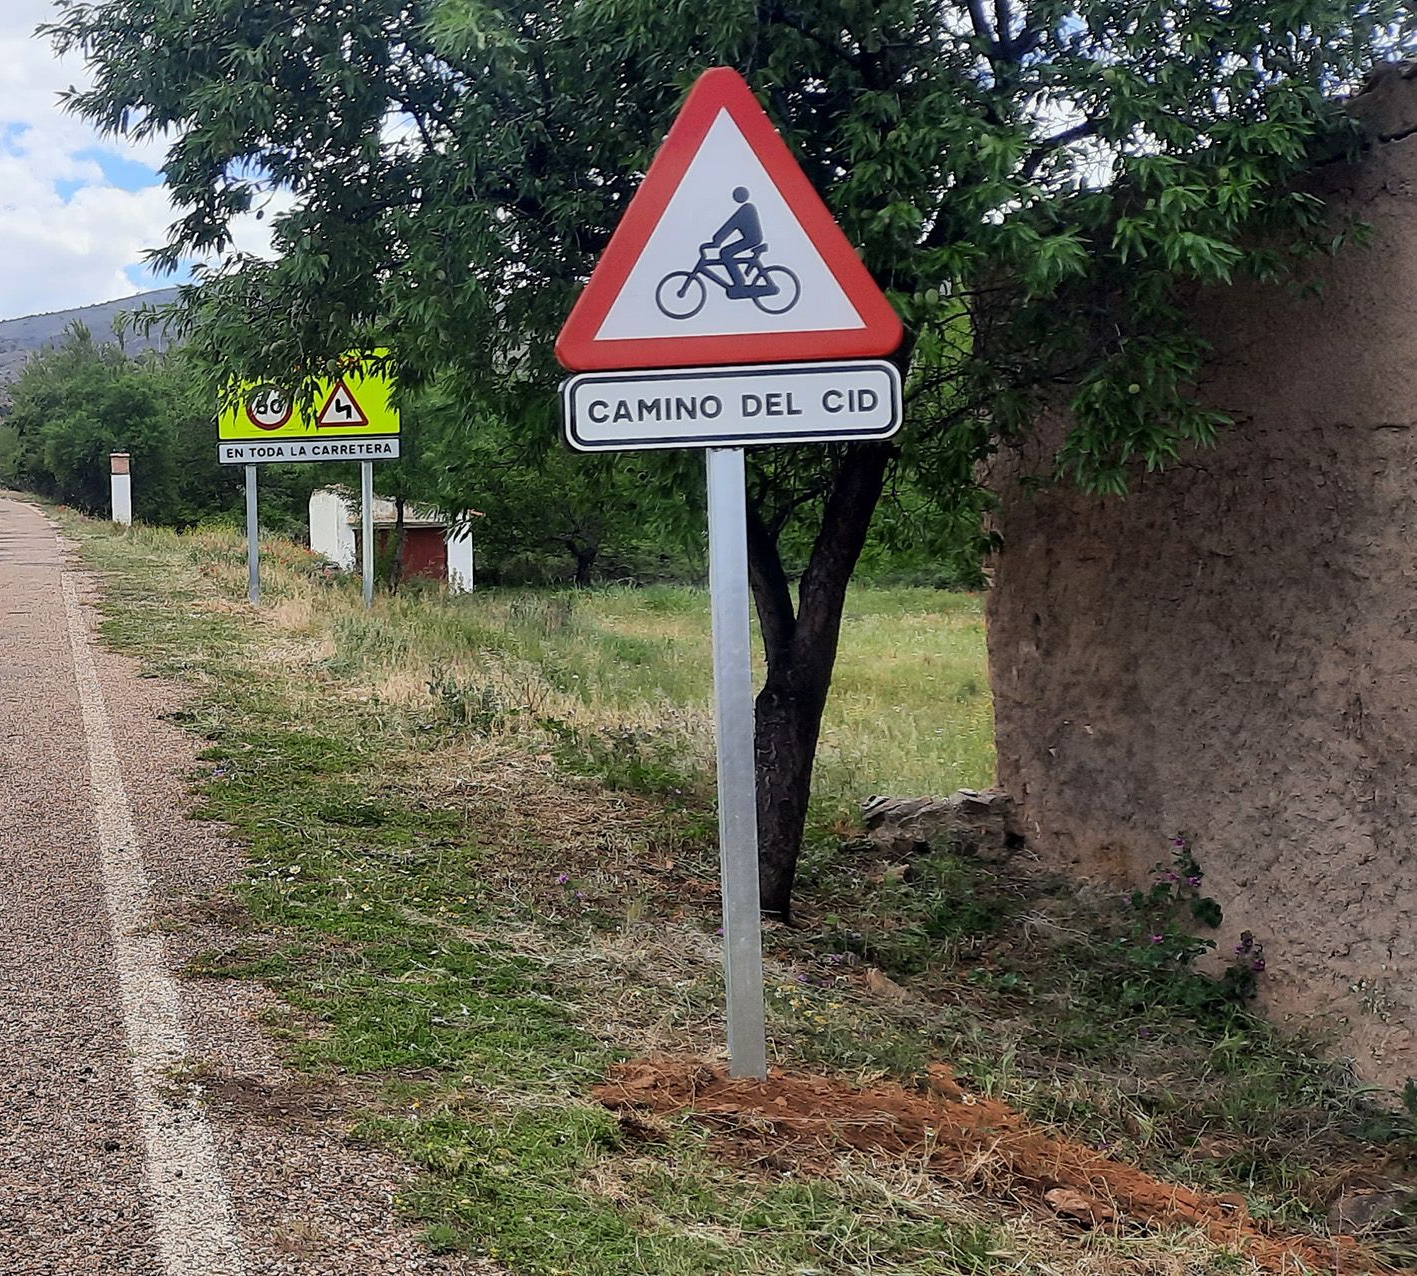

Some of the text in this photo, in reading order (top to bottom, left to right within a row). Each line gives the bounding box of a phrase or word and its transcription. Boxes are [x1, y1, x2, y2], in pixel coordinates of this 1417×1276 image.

[588, 389, 879, 424] CAMINO DEL CID
[227, 442, 392, 459] EN TODA LA CARRETERA
